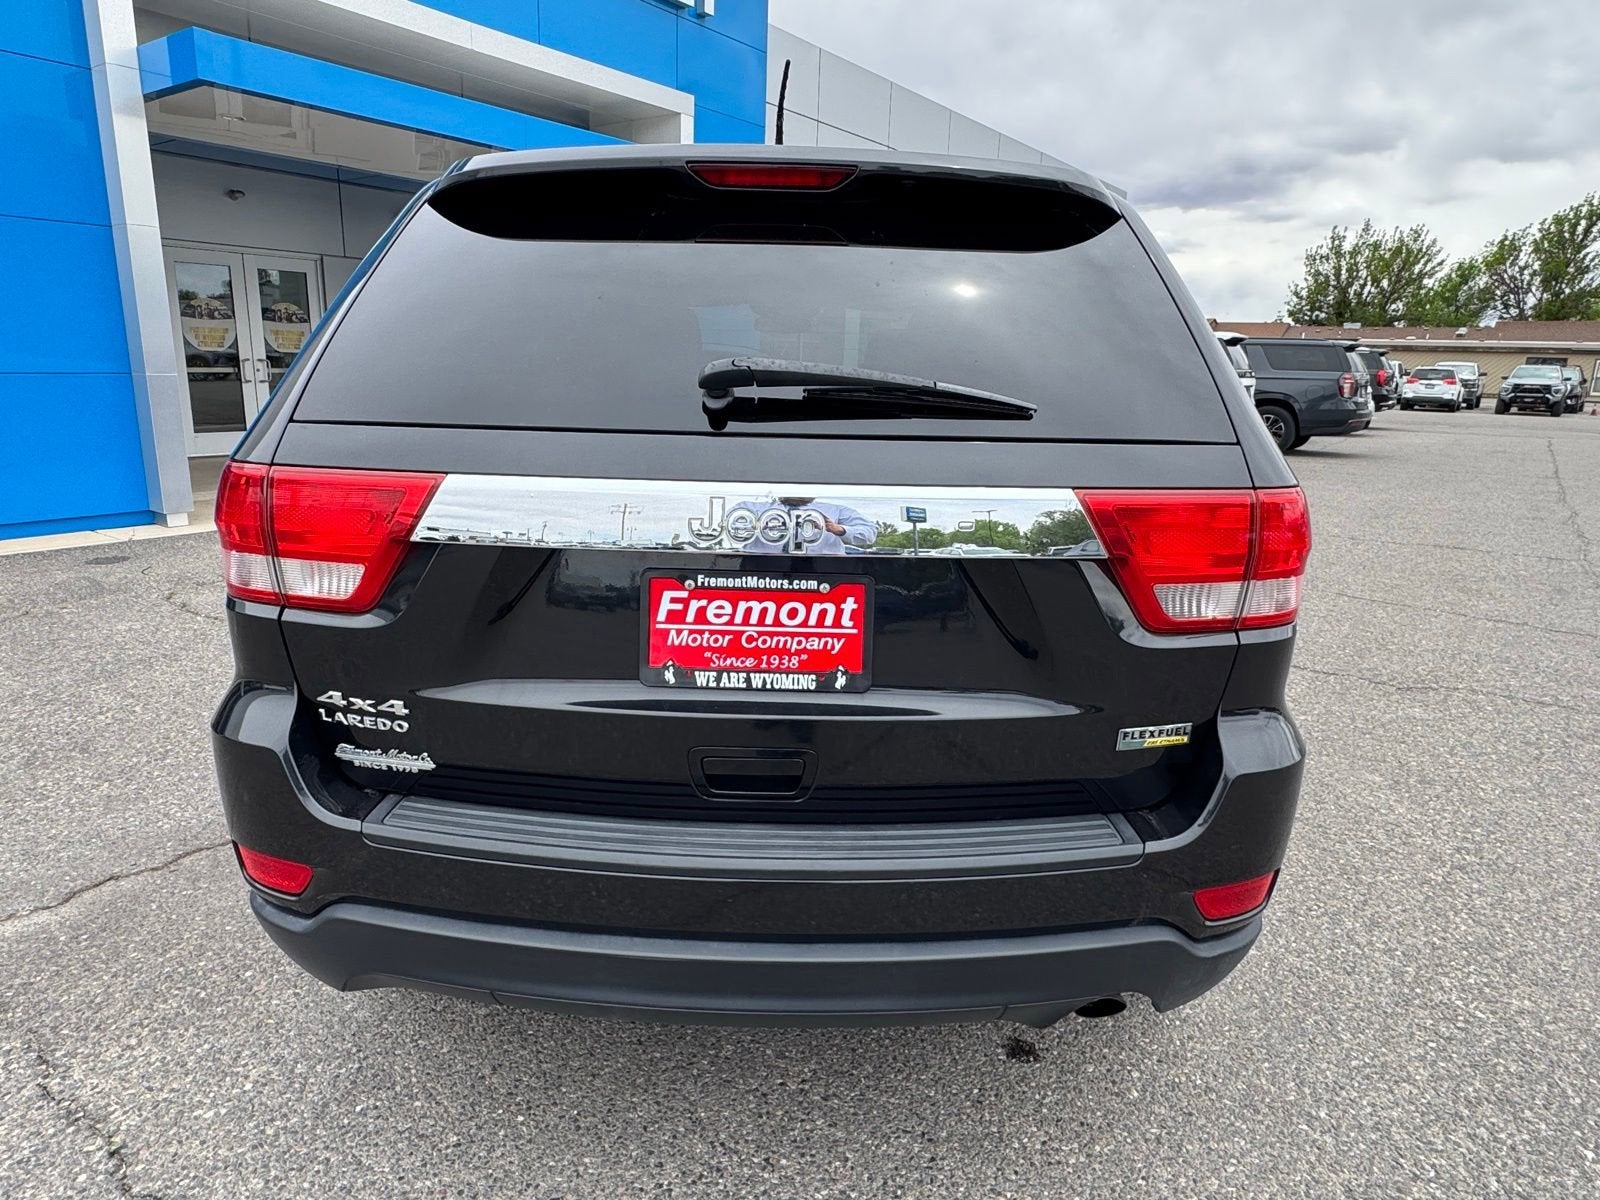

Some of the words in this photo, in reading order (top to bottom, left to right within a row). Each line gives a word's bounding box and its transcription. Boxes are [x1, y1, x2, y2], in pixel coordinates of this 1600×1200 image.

[687, 496, 826, 554] Jeep
[696, 574, 818, 591] FremontMotors.com
[655, 590, 859, 628] Fremont
[667, 629, 734, 648] Motor
[741, 631, 846, 654] Company
[694, 671, 719, 688] WE
[720, 671, 747, 689] ARE
[749, 672, 817, 690] WYOMING
[318, 708, 410, 733] LAREDO
